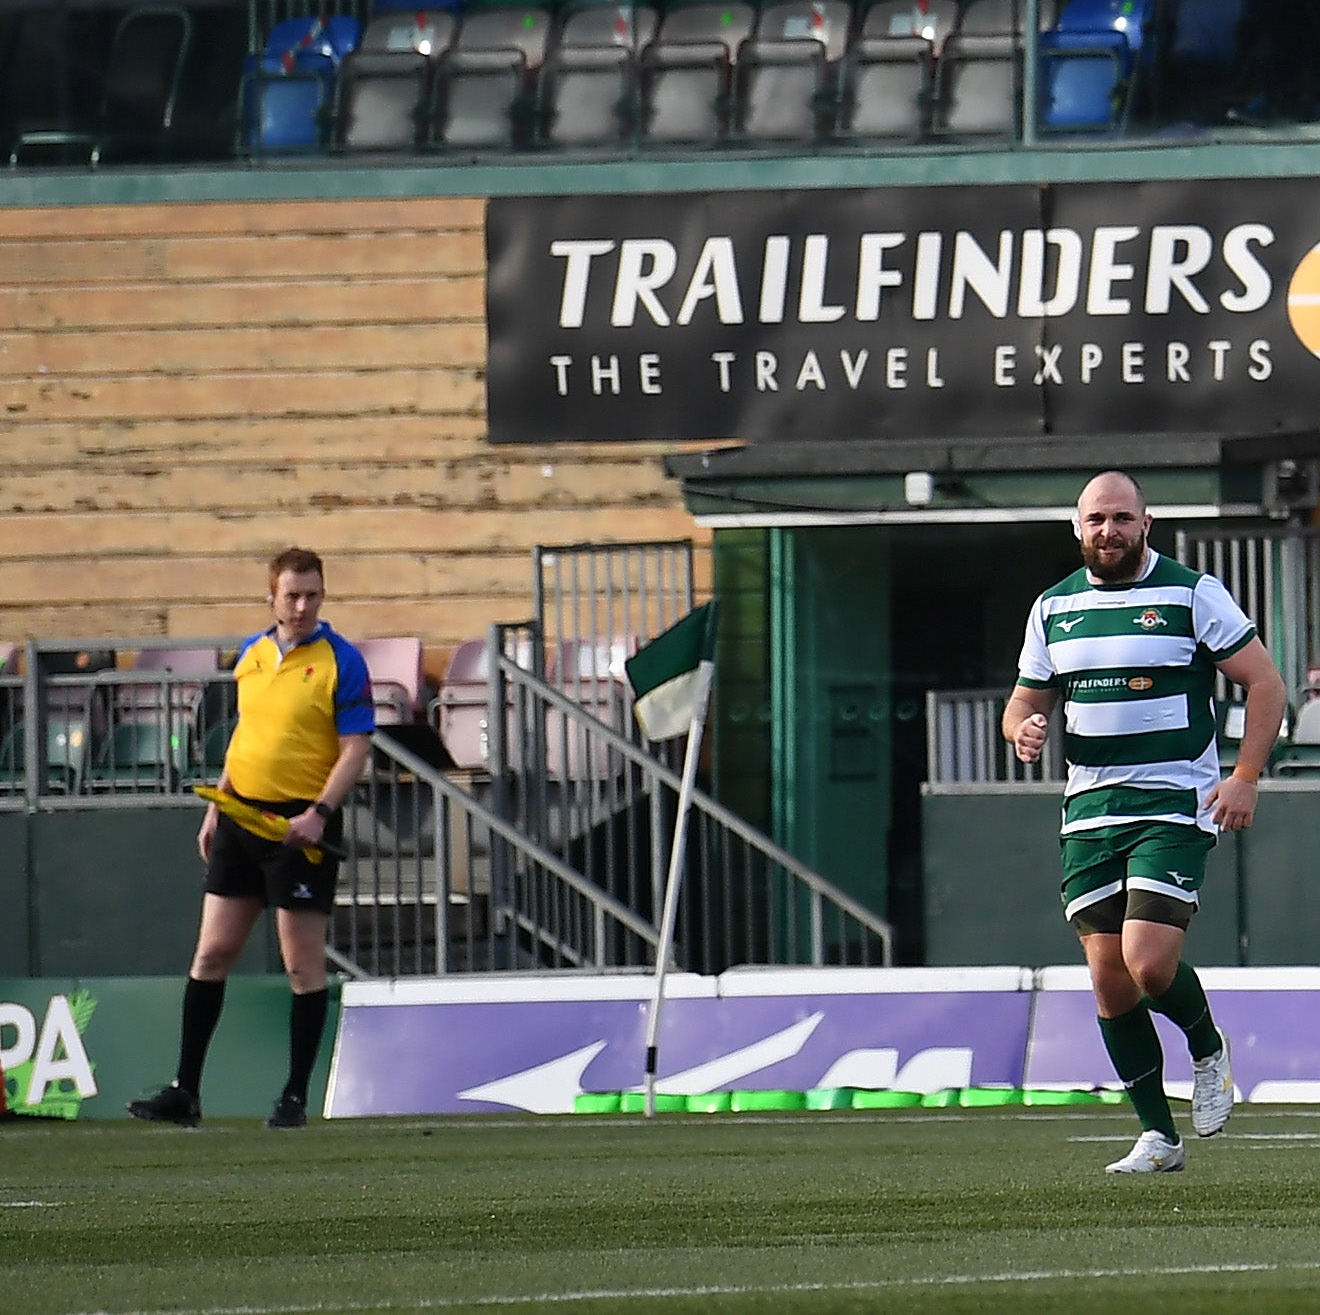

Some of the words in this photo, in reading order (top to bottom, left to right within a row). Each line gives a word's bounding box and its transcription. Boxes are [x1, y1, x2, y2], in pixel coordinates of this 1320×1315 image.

[551, 223, 1275, 328] TRAILFINDERS
[550, 353, 662, 396] THE
[711, 346, 944, 393] TRAVEL
[994, 339, 1273, 387] EXPERTS
